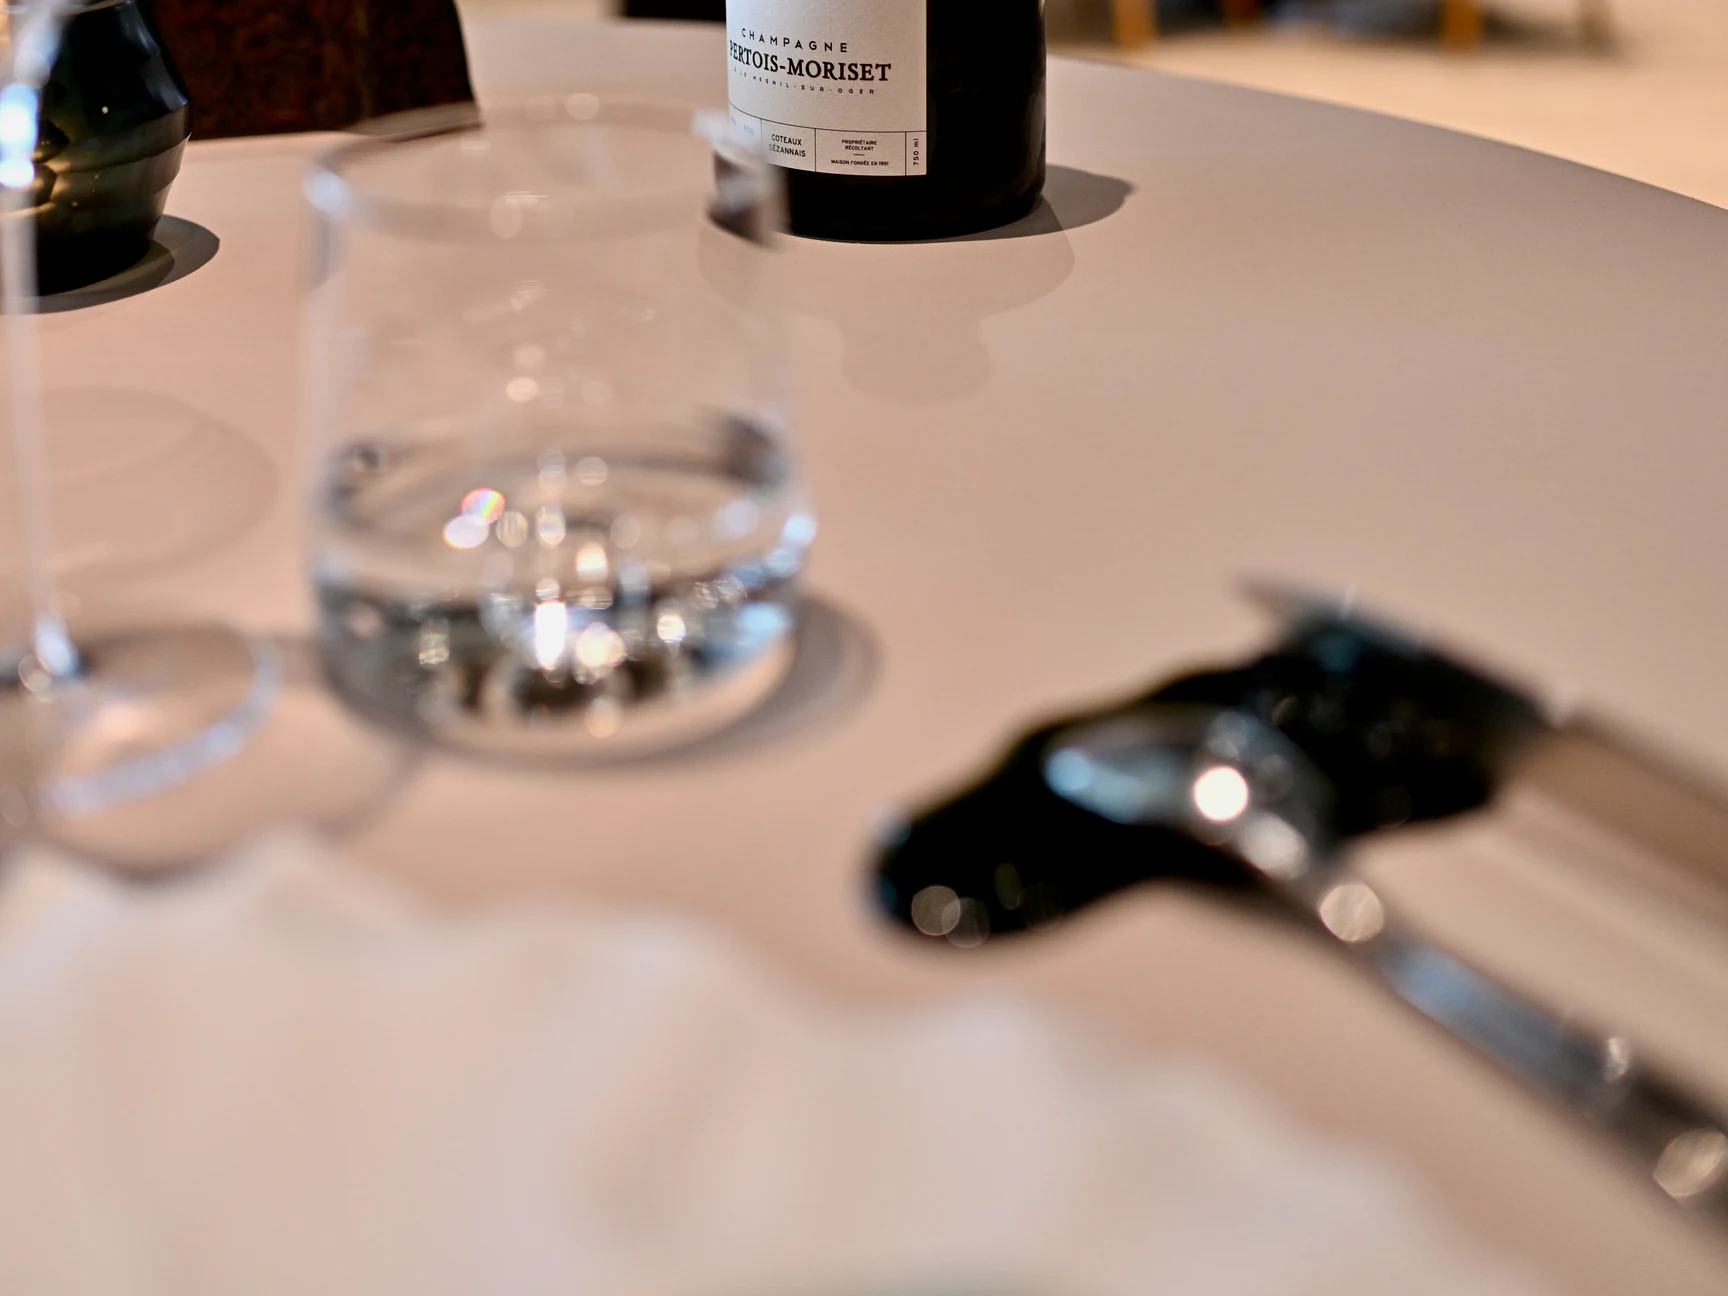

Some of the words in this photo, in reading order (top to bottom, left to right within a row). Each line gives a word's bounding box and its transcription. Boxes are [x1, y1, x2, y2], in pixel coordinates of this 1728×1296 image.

[741, 27, 848, 53] CHAMPAGNE
[729, 39, 892, 82] PERTOIS-MORISET
[752, 75, 875, 95] MESNIL-SUR-OGER
[771, 133, 802, 147] COTEAUX
[841, 138, 878, 146] PROPRIÉTAIRE
[912, 138, 920, 148] ml
[768, 143, 806, 158] SÉZANNAIS
[844, 144, 875, 152] RÉCOLTANT
[912, 150, 920, 166] 750
